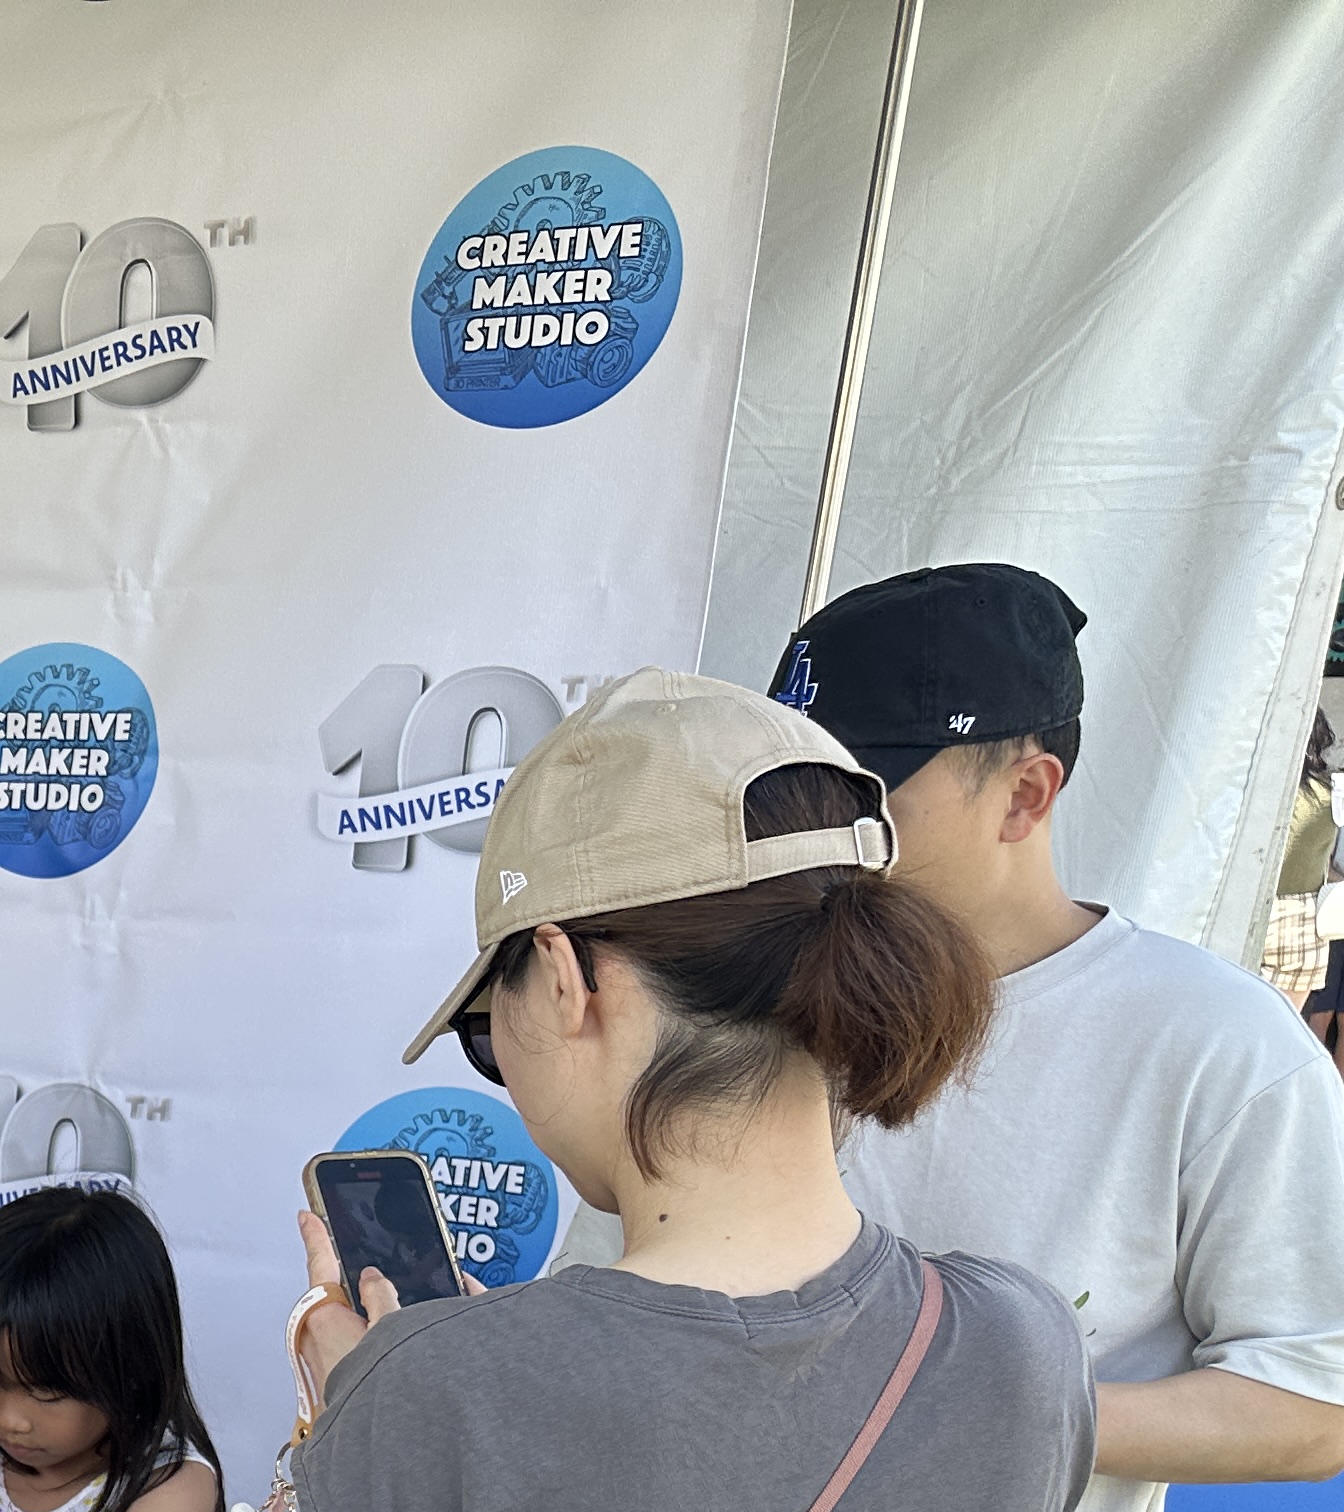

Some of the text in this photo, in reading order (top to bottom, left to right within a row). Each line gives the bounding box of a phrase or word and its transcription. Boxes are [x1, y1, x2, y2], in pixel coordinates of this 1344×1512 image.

[456, 221, 644, 270] CREATIVE
[472, 270, 611, 310] MAKER
[464, 312, 609, 352] STUDIO
[11, 321, 201, 399] ANNIVERSARY
[0, 748, 109, 777] MAKER
[336, 778, 512, 836] ANNIVERSA
[431, 1156, 525, 1194] ATIVE
[438, 1193, 499, 1228] KER
